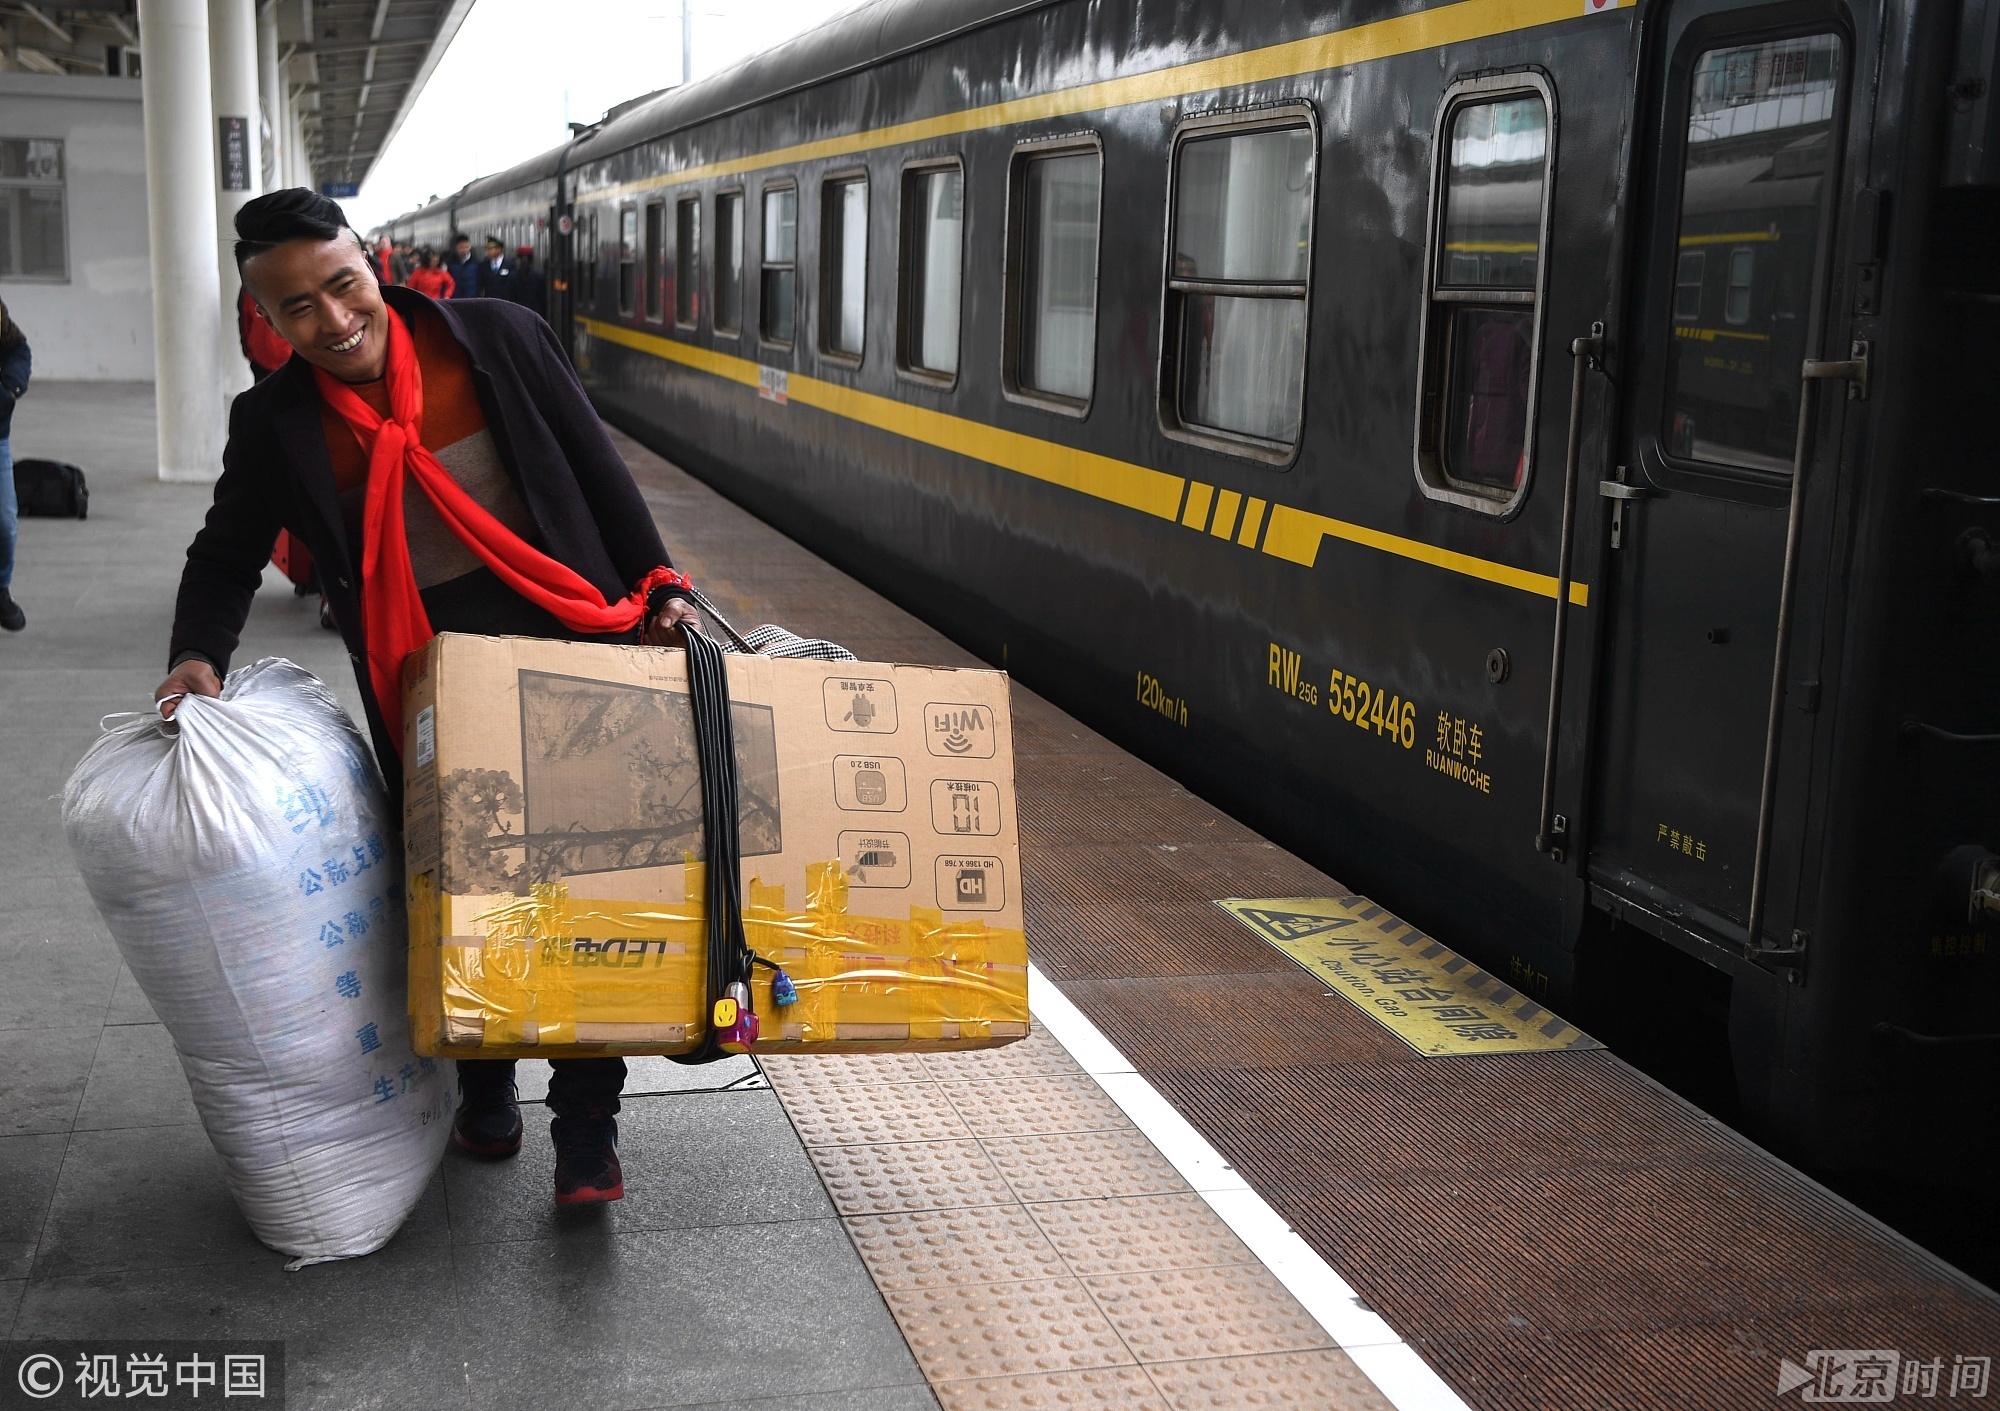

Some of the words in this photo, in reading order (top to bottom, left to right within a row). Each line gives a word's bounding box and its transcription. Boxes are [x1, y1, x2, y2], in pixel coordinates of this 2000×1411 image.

[840, 681, 875, 692] 安卓智能
[1136, 670, 1188, 728] 120km/h
[934, 708, 985, 736] WiFi
[1328, 668, 1416, 750] 552446
[1436, 710, 1483, 766] 软卧车
[1426, 748, 1491, 794] RUANWOCHE
[858, 838, 890, 849] 节能设计
[1657, 823, 1707, 862] 严禁敲击
[959, 878, 983, 895] HD
[336, 970, 362, 999] 等
[1320, 958, 1373, 998] Caution,
[1374, 997, 1408, 1018] Gap
[1325, 937, 1519, 1041] 小心站台间隙
[1510, 954, 1550, 998] 注水口
[356, 1021, 383, 1056] 重
